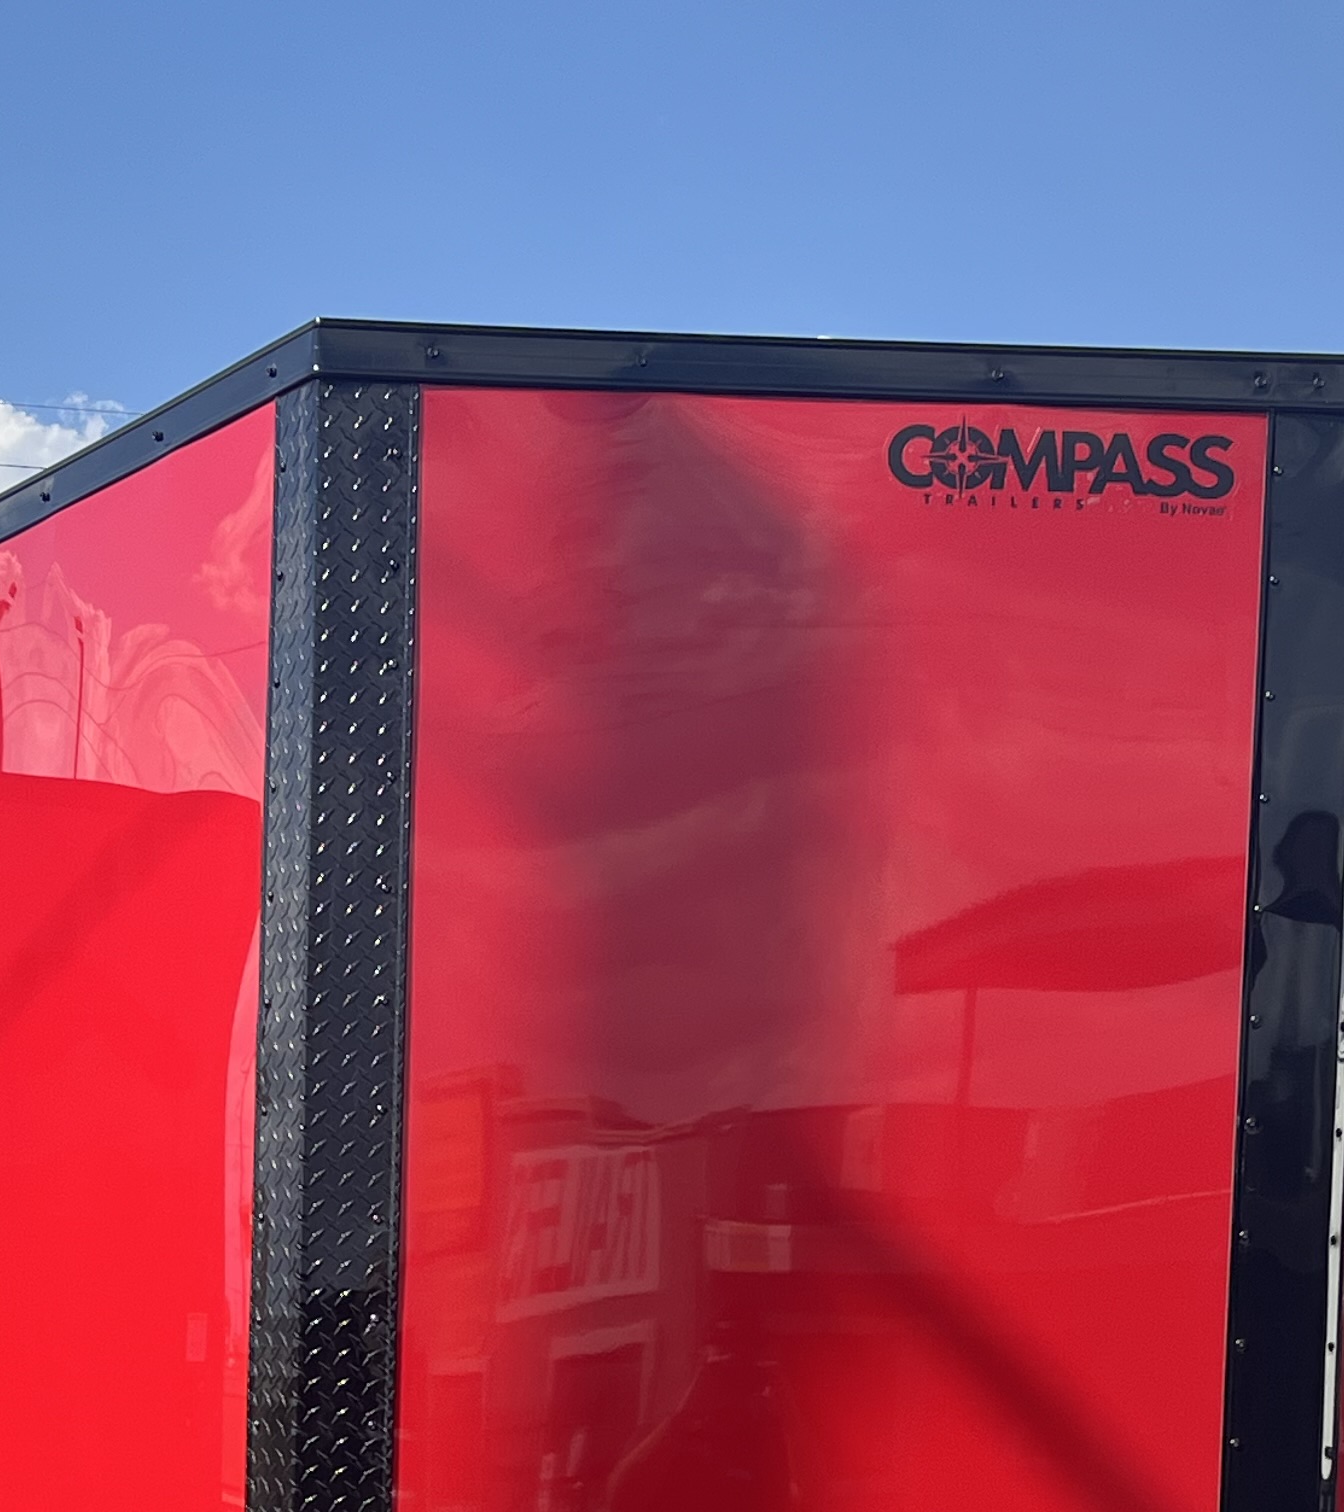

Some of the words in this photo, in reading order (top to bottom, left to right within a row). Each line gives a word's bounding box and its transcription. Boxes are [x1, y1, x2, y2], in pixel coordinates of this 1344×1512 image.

[888, 424, 1235, 500] COMPASS
[923, 494, 1085, 510] TRAILERS
[1160, 501, 1178, 517] By
